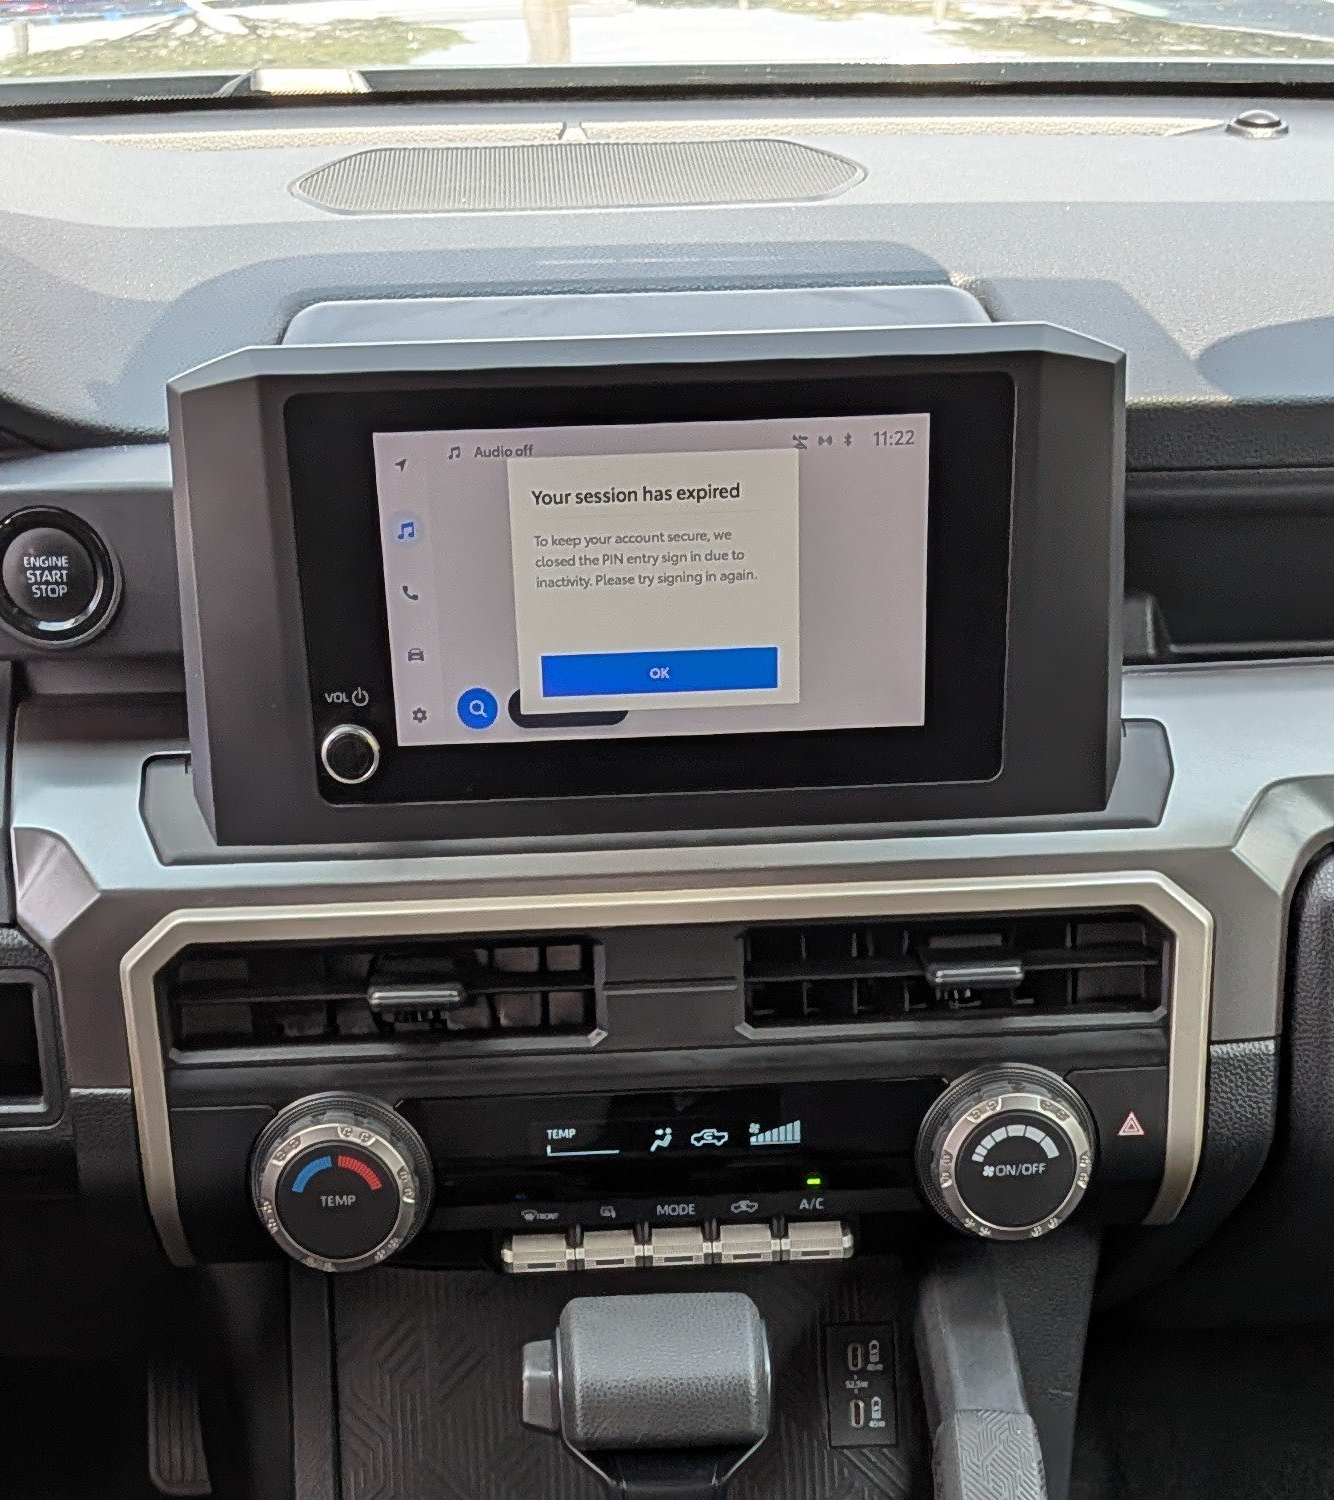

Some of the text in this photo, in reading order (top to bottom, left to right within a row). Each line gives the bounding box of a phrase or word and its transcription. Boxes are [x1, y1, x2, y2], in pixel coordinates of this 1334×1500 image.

[873, 429, 915, 447] 11:22
[474, 443, 534, 459] Audio off
[531, 482, 741, 505] Your session has expired
[534, 530, 732, 548] To keep your account secure, we
[23, 555, 69, 568] ENGINE
[535, 549, 745, 568] closed the PIN entry sign in due to
[26, 569, 68, 584] START
[536, 569, 757, 589] inactivity. Please try signing in again.
[31, 584, 68, 598] STOP
[649, 667, 670, 680] OK
[324, 691, 349, 704] VOL
[546, 1128, 577, 1140] TEMP
[995, 1162, 1046, 1177] ON/OFF
[320, 1195, 357, 1208] TEMP
[798, 1197, 825, 1211] A/C
[656, 1203, 696, 1216] MODE
